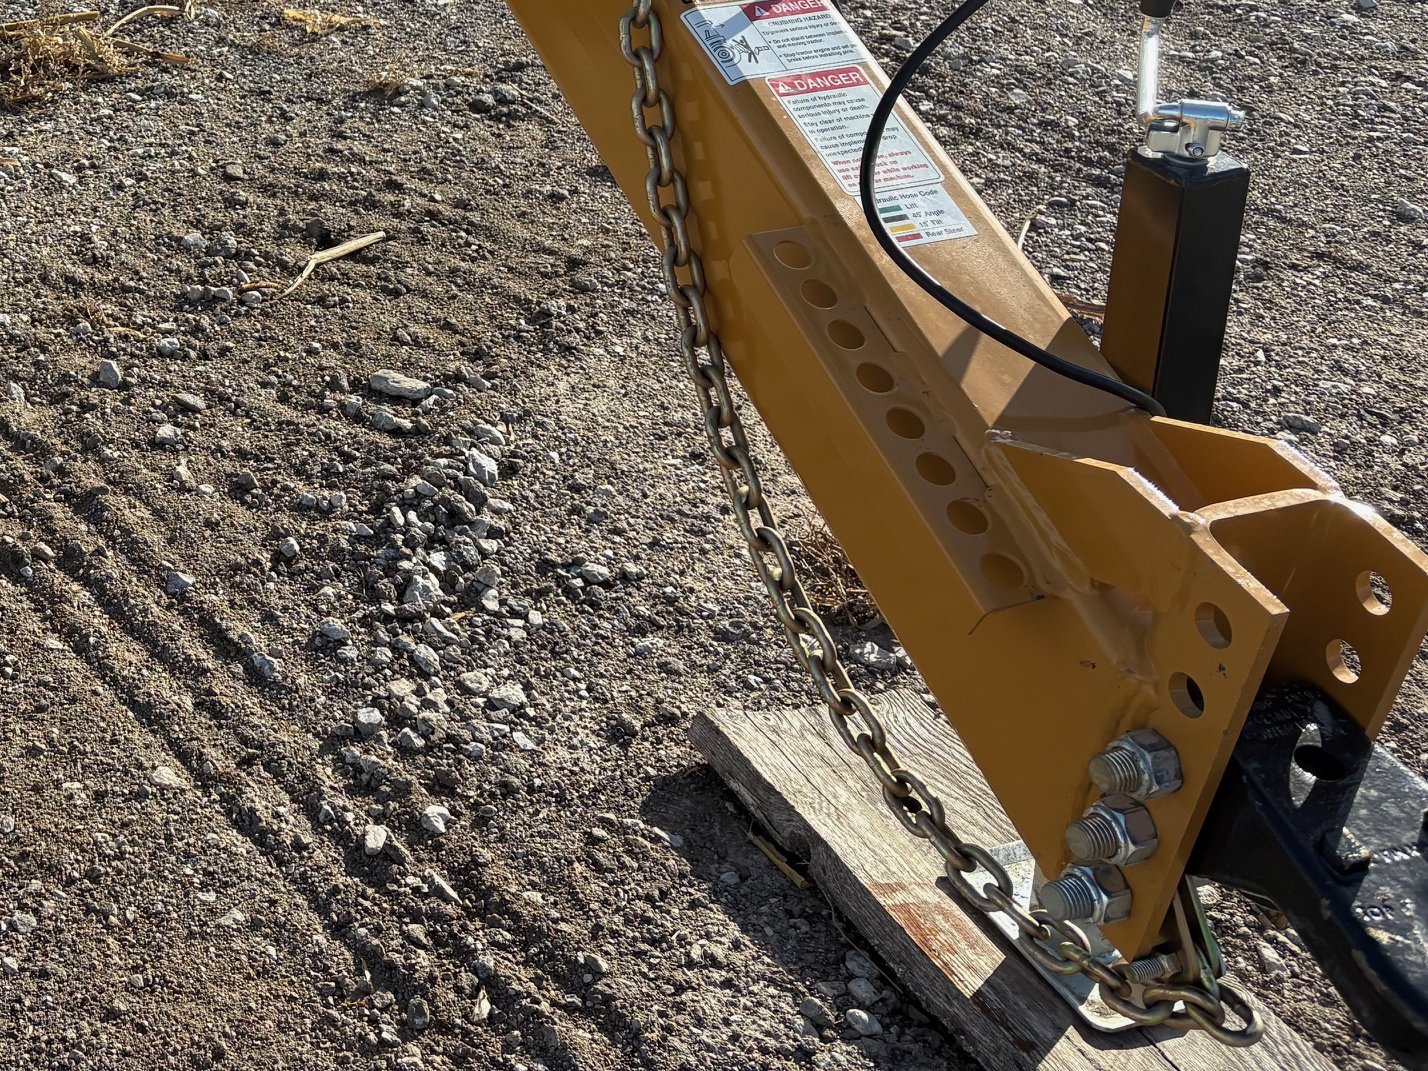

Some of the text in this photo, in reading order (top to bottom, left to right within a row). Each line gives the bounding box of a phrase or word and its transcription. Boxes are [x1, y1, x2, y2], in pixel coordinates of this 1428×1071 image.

[768, 13, 832, 26] CRUSHING HAZARD
[794, 71, 864, 91] DANGER
[787, 97, 810, 105] Failure
[818, 92, 847, 101] hydraulic
[793, 102, 831, 111] components
[798, 111, 821, 119] serious
[821, 108, 840, 116] injury
[844, 113, 870, 121] machine
[816, 125, 849, 134] operation.
[900, 191, 919, 200] Hose
[918, 189, 939, 197] Code
[924, 208, 945, 217] Angle
[931, 219, 944, 227] Tilt
[926, 227, 964, 238] Rear Steer
